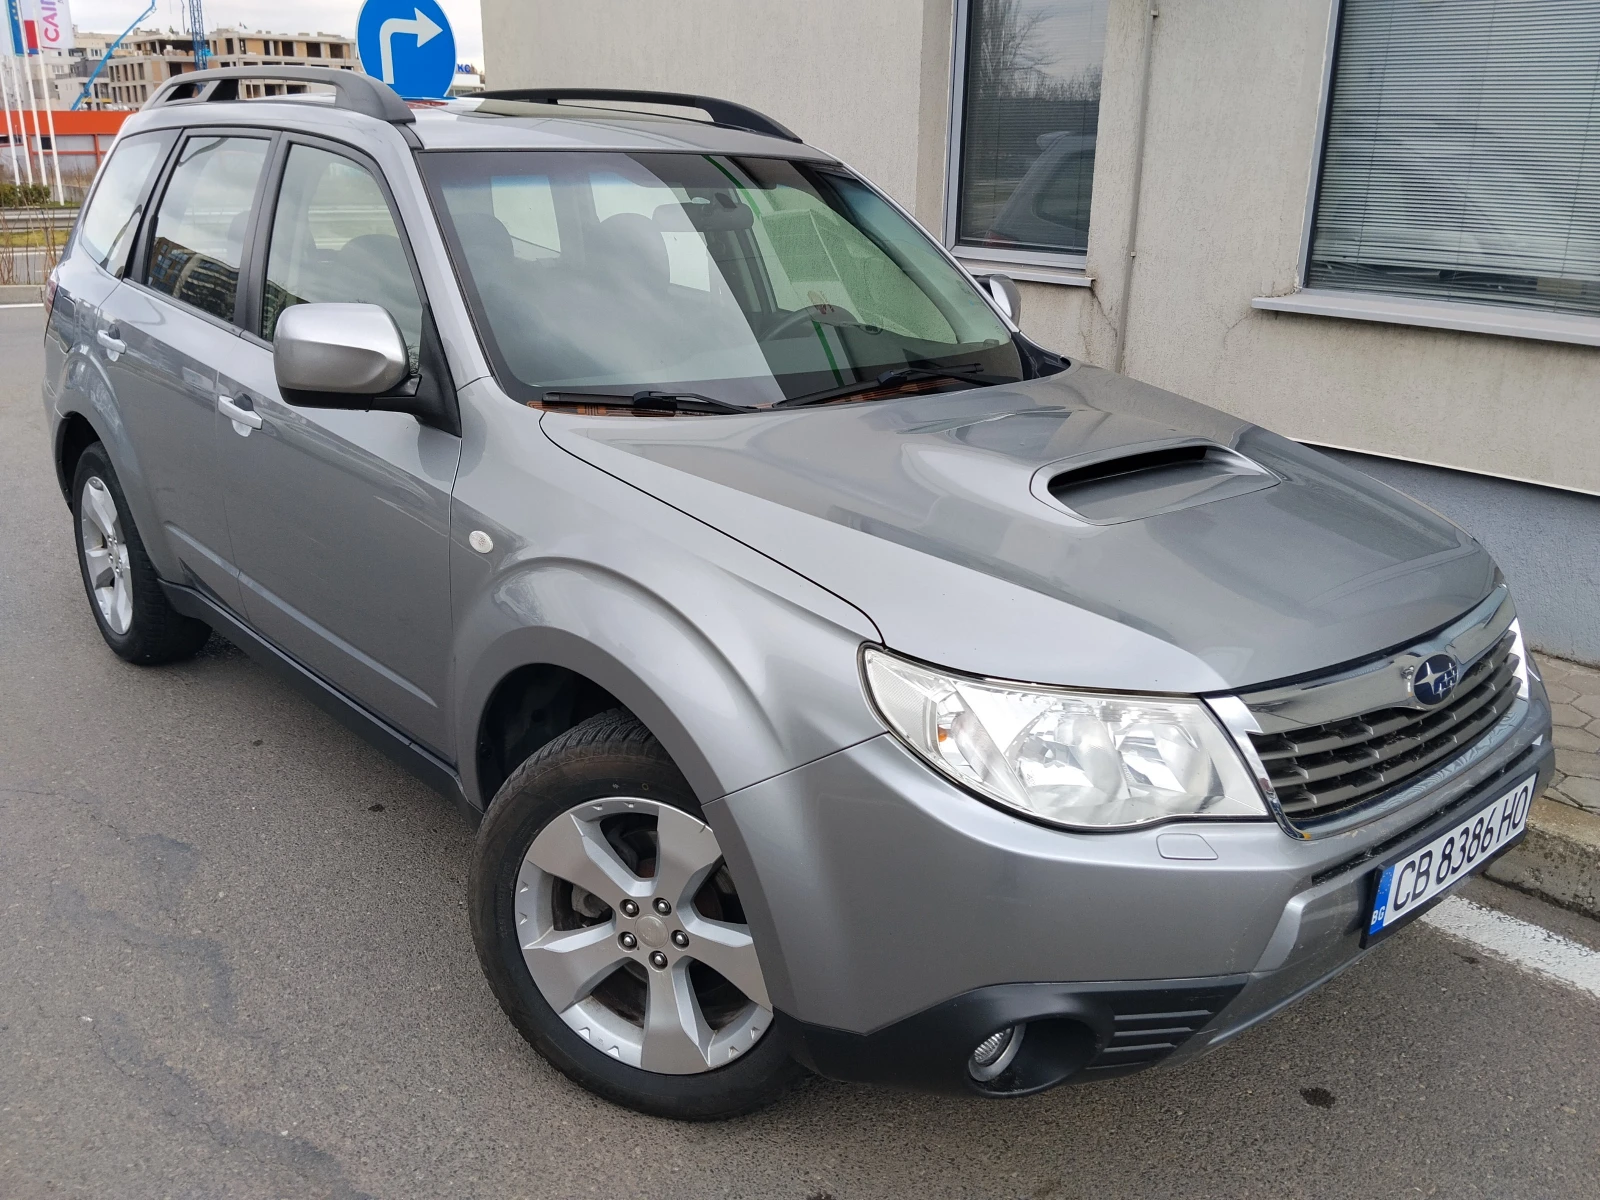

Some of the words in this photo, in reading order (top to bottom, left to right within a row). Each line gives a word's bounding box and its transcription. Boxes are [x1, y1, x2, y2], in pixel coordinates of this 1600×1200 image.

[1393, 849, 1433, 911] CB
[1436, 807, 1497, 885] 8386
[1496, 785, 1529, 843] HO
[1371, 905, 1386, 926] BG
